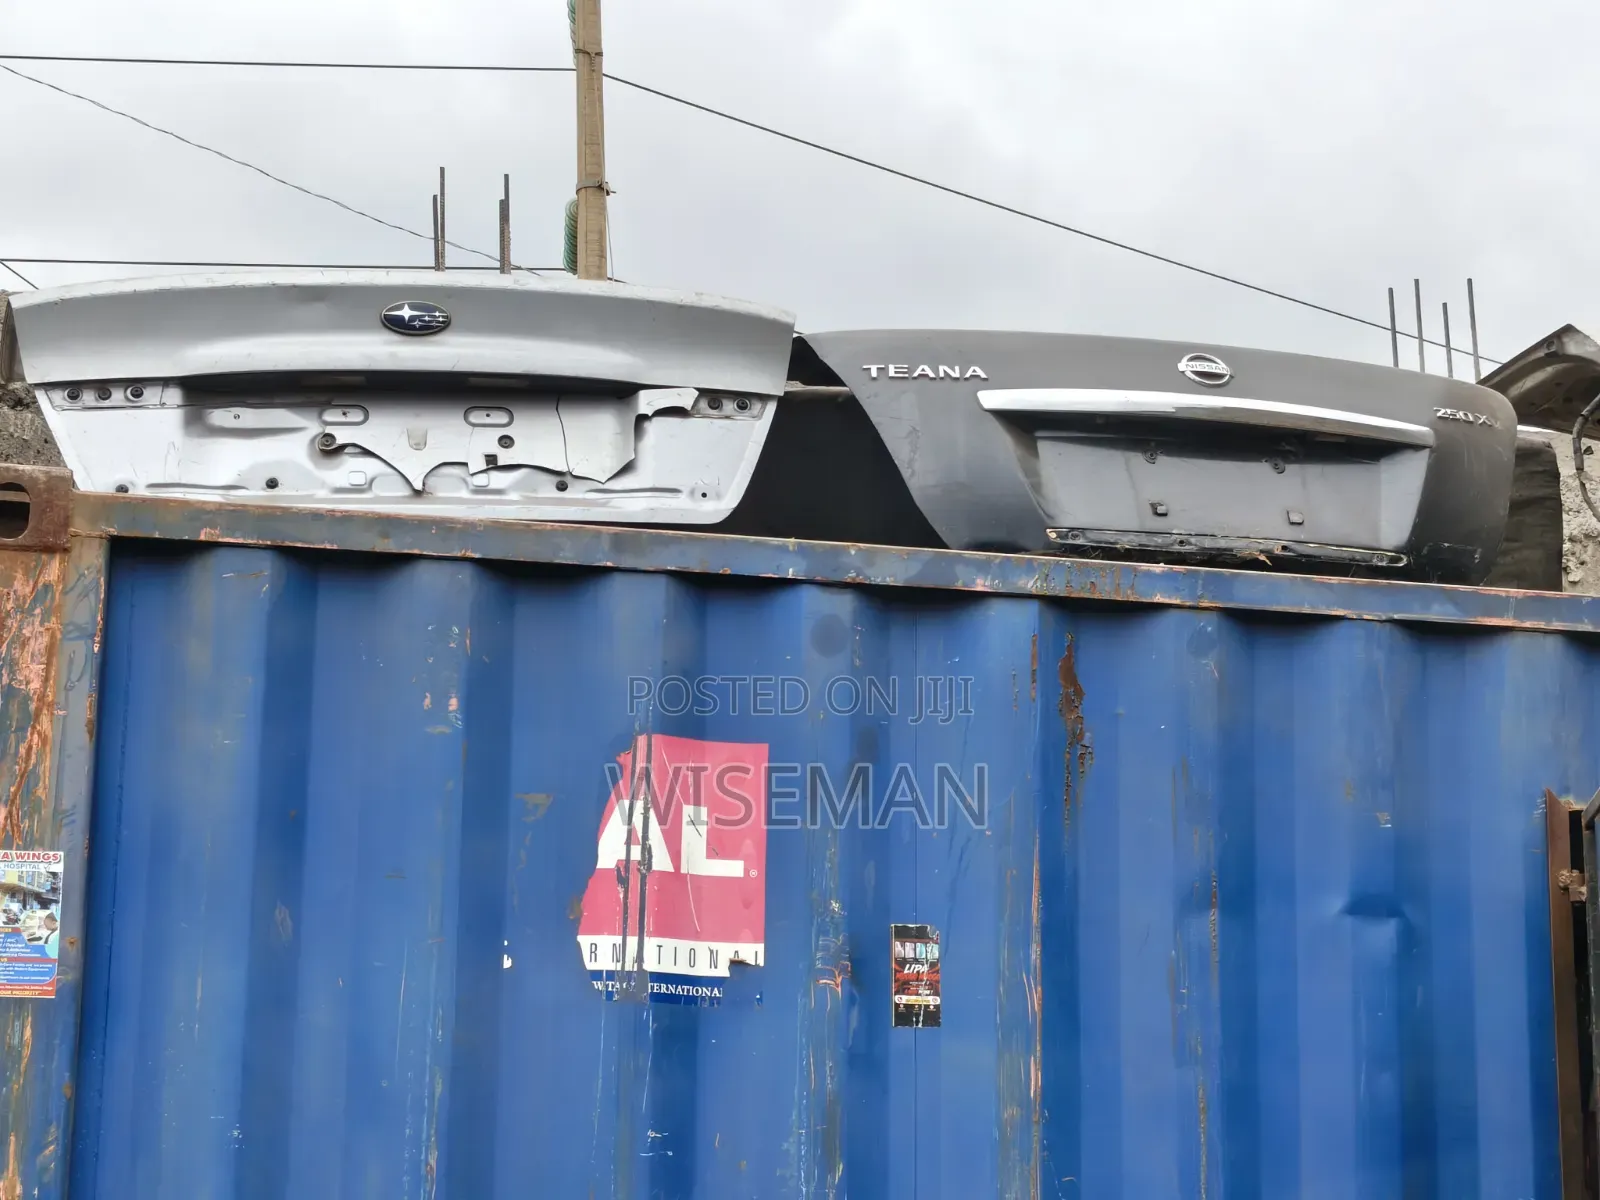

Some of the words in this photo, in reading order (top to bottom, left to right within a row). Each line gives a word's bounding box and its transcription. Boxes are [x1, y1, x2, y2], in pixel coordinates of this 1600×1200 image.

[862, 364, 989, 380] TEANA
[1185, 363, 1229, 374] NISSAN
[1433, 406, 1475, 424] 250
[0, 851, 12, 861] A
[14, 851, 60, 862] WINGS
[904, 963, 928, 974] LIPA
